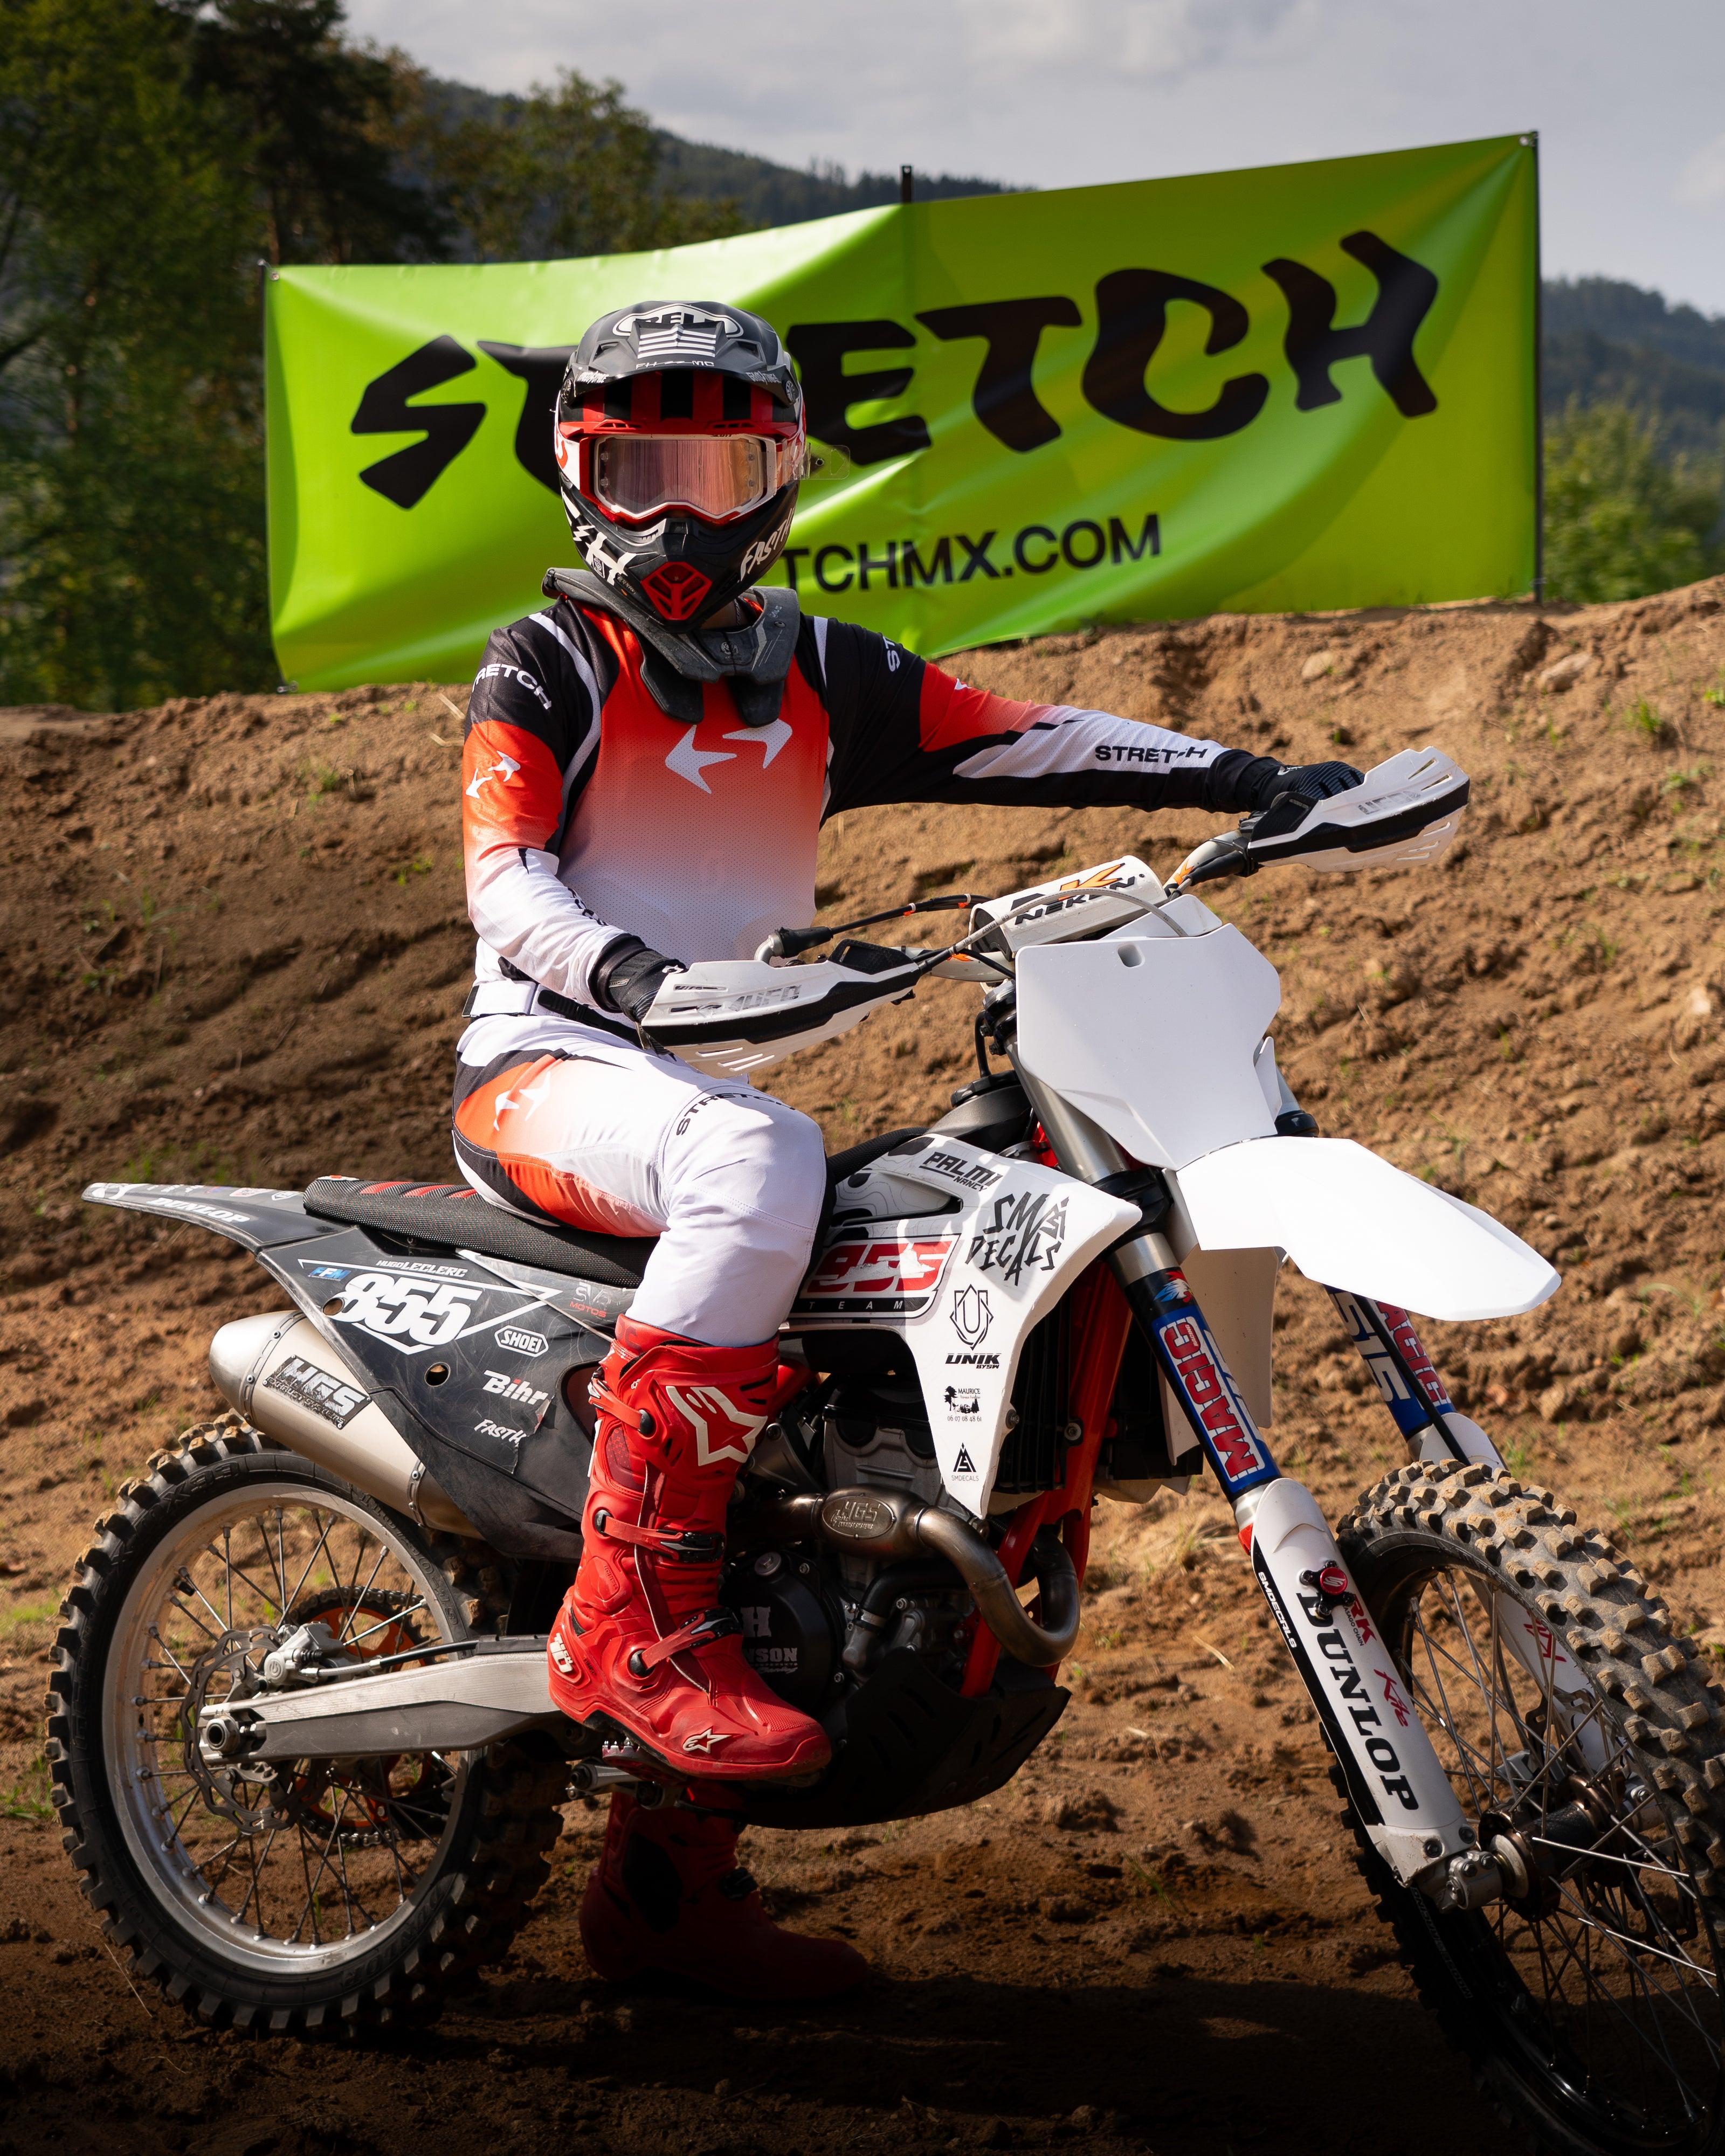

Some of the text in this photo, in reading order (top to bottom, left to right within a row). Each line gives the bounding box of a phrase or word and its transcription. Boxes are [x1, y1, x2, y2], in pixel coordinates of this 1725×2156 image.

[350, 230, 1439, 510] STETCH
[954, 1176, 987, 1191] NANCY
[146, 1197, 251, 1223] DUNLOP
[967, 1232, 1061, 1286] DECALS
[325, 1273, 483, 1345] 855
[569, 1301, 606, 1317] MOTOS
[809, 1300, 903, 1310] TEAM
[501, 1330, 542, 1353] SHOEI
[945, 1353, 1002, 1364] UNIK
[276, 1358, 366, 1416] HGS
[482, 1370, 548, 1405] Bihr
[1164, 1322, 1259, 1479] MAGIC
[741, 1606, 772, 1637] H
[1258, 1571, 1297, 1648] SMDECALS
[1350, 1594, 1377, 1644] RK
[554, 1633, 573, 1663] TECH
[1353, 1627, 1364, 1647] CHAIN
[550, 1641, 573, 1673] 10
[1296, 1592, 1419, 1811] DUNLOP
[1374, 1669, 1410, 1727] Kite
